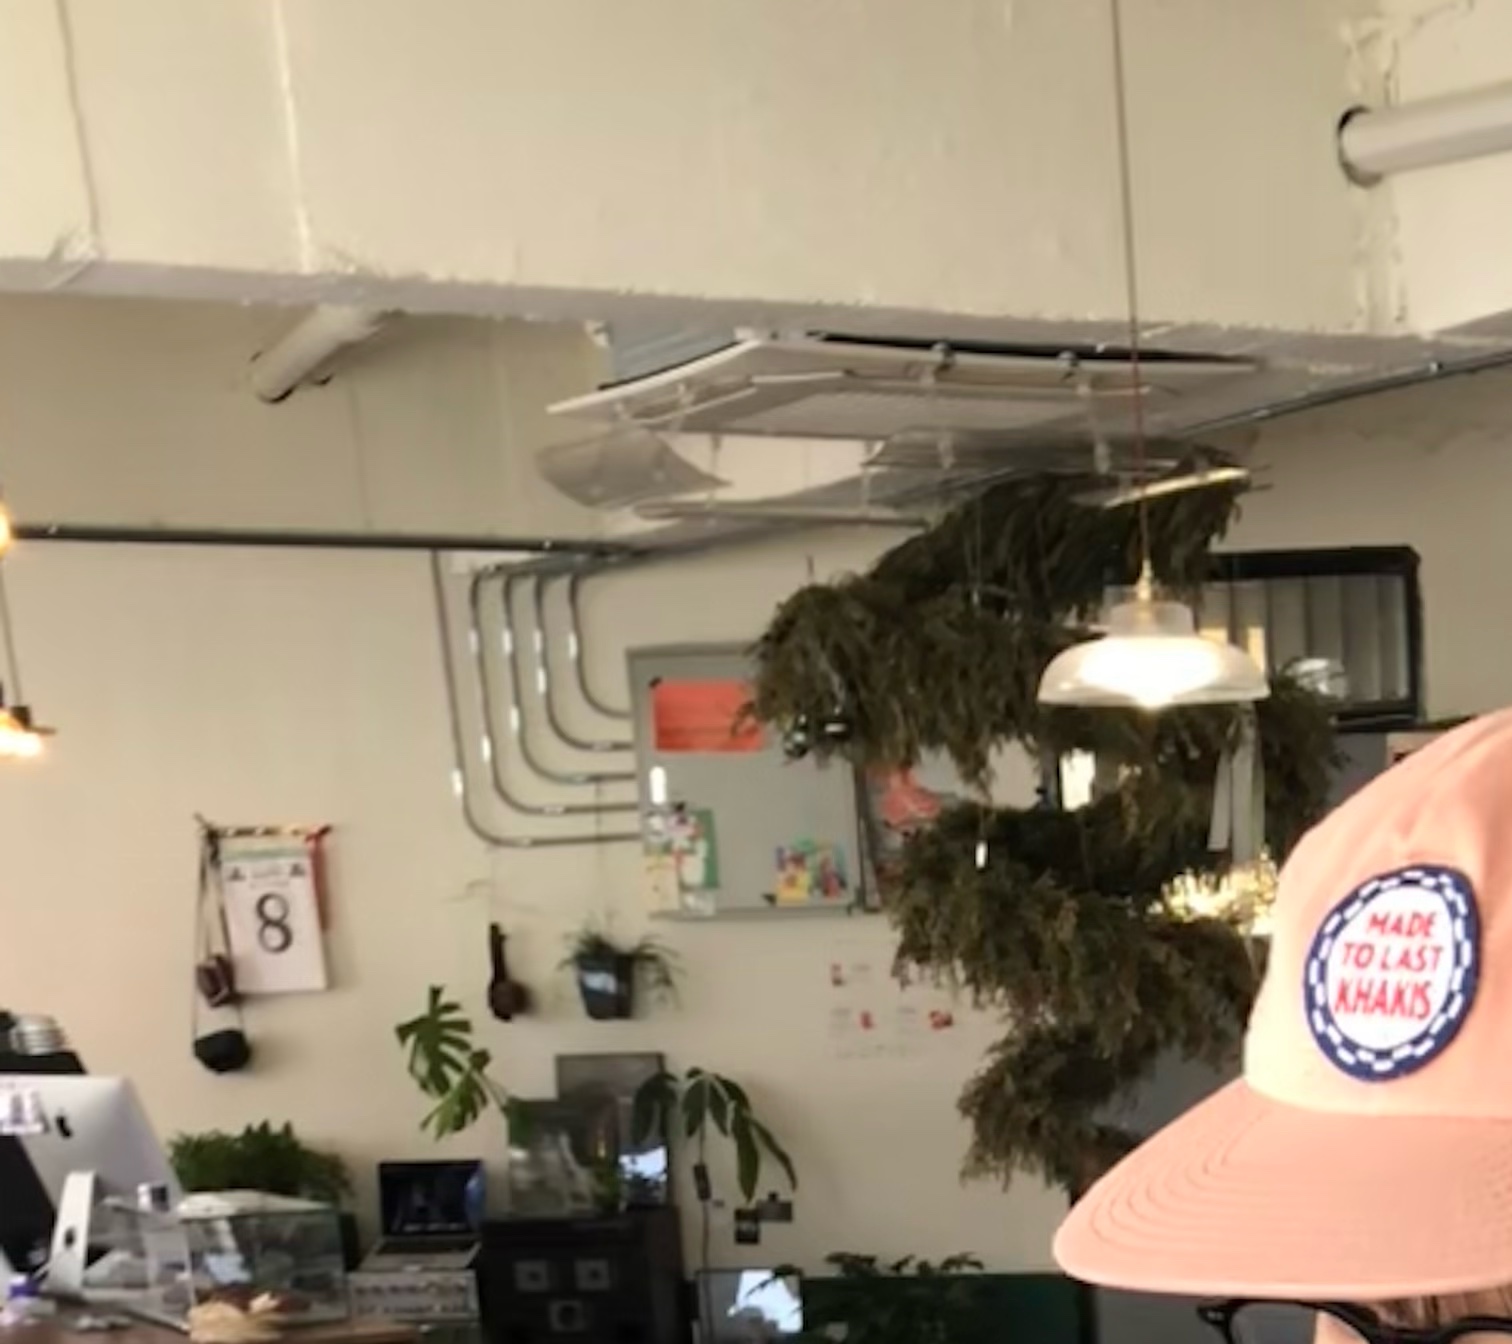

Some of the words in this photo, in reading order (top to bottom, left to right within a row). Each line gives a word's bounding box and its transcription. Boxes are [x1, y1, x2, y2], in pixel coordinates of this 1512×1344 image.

[256, 893, 293, 953] 8
[1368, 912, 1437, 936] MADE
[1344, 942, 1375, 967] TO
[1382, 945, 1443, 971] LAST
